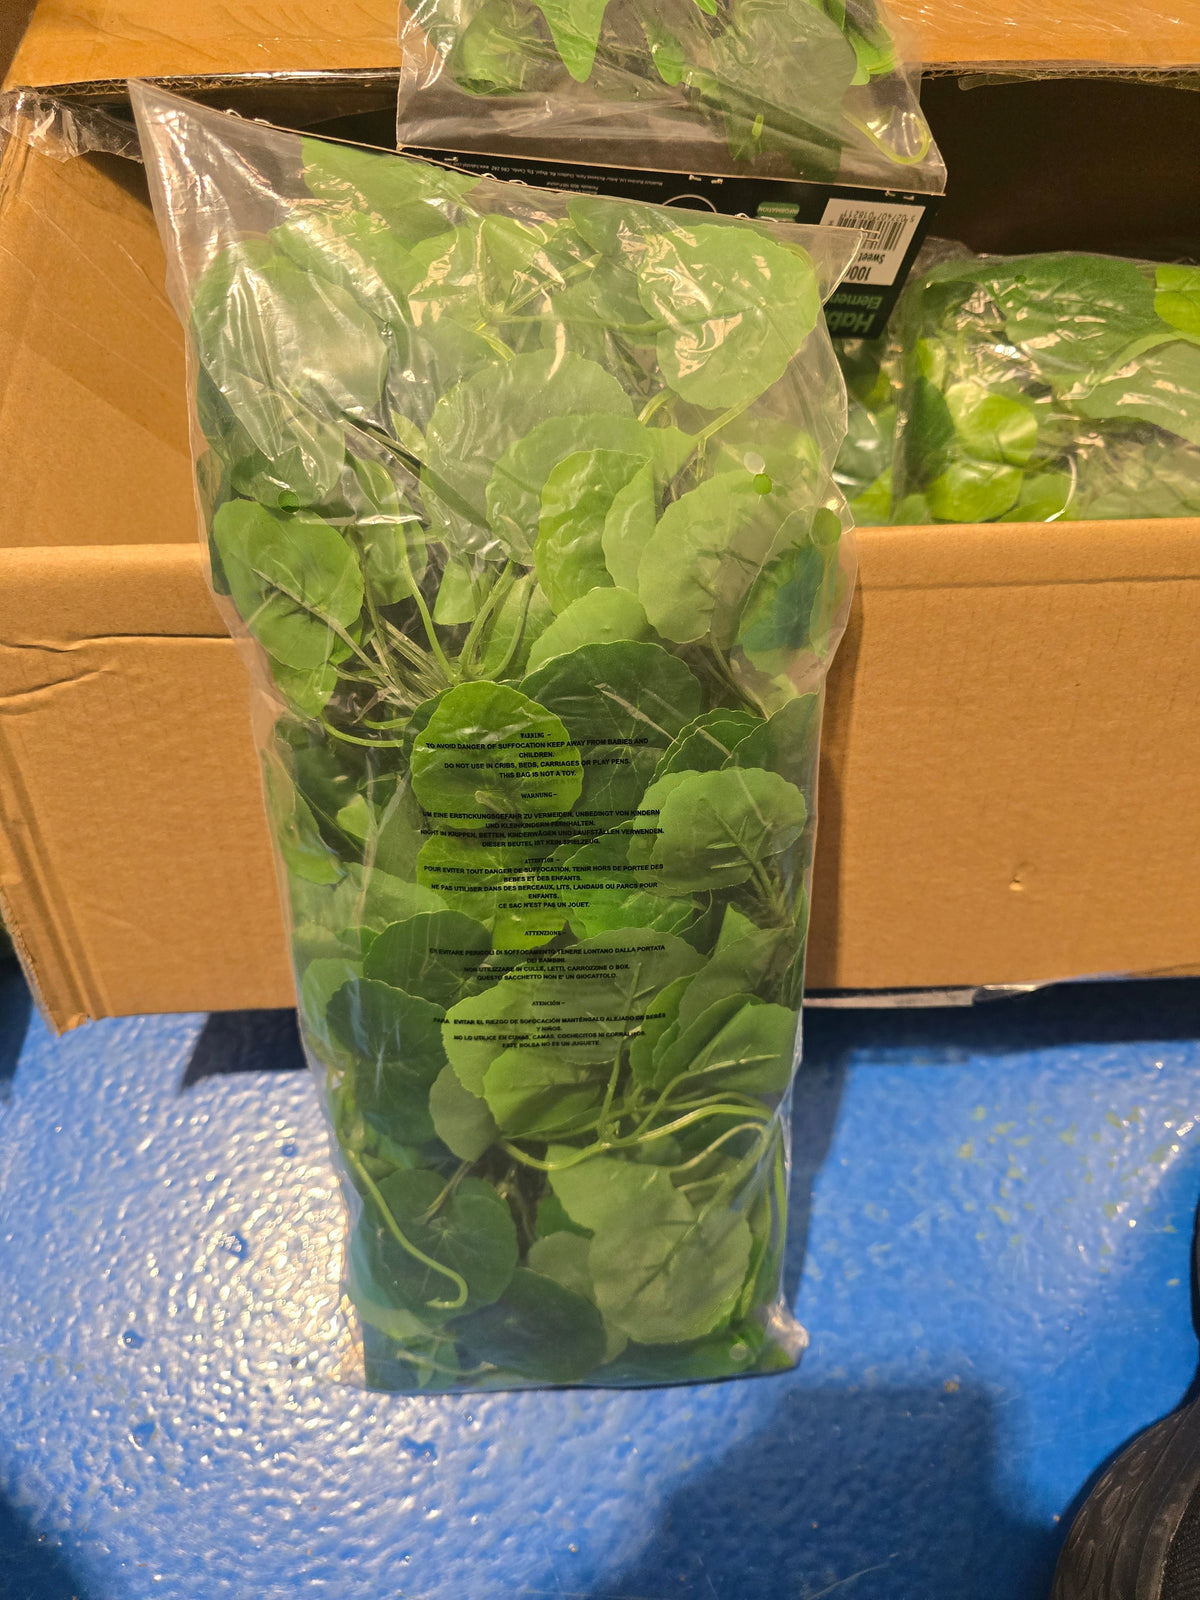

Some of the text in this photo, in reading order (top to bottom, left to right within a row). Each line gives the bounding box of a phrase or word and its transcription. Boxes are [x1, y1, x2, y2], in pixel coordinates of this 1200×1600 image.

[858, 252, 886, 264] Sweet
[830, 294, 884, 310] Elemen
[826, 311, 875, 333] Hab
